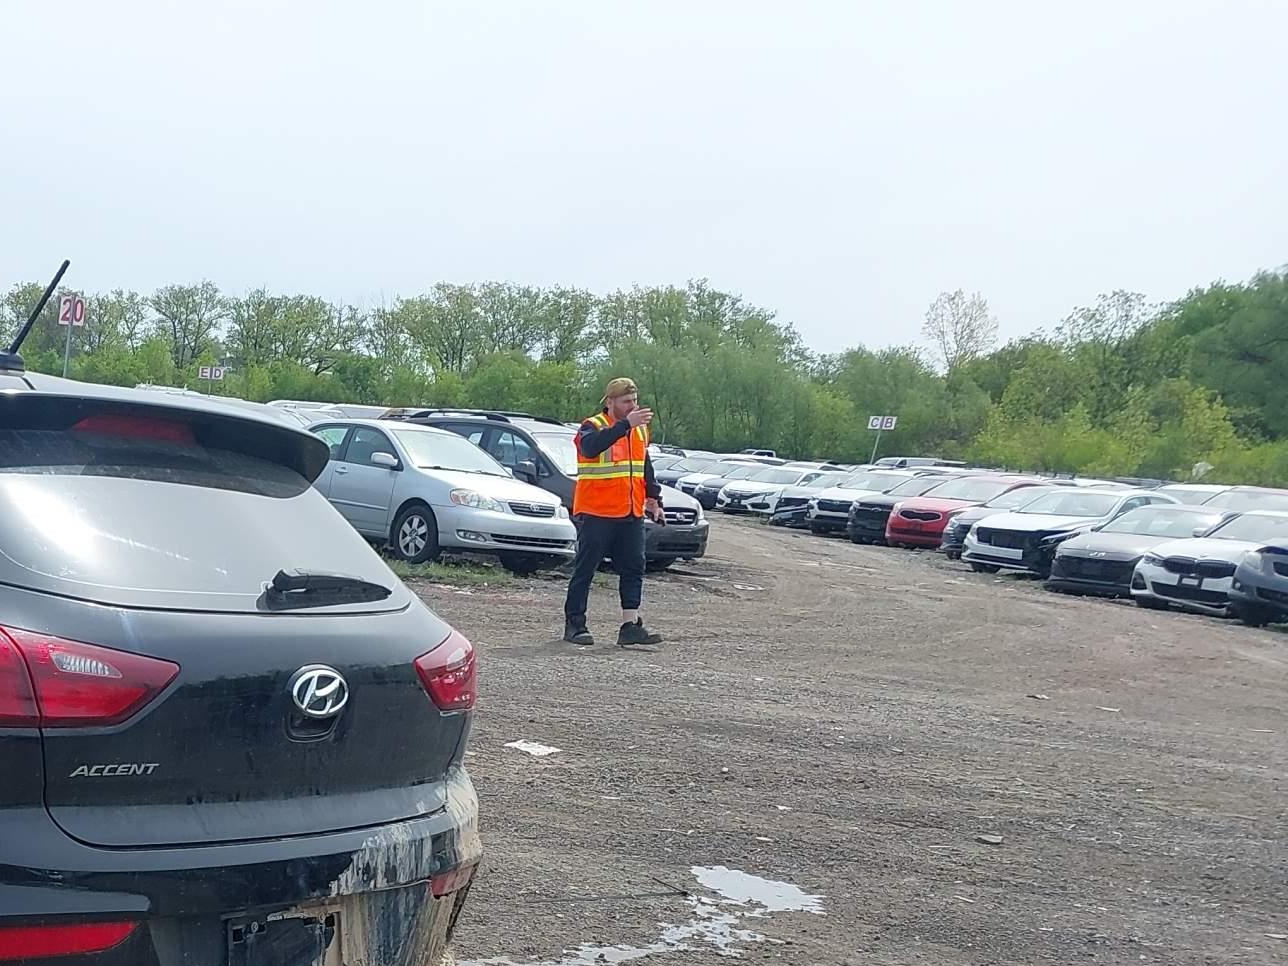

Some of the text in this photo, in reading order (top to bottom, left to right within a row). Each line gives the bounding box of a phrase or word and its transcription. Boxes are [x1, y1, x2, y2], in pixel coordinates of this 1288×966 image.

[61, 298, 84, 322] 20
[871, 417, 894, 428] C B
[68, 763, 160, 777] ACCENT
